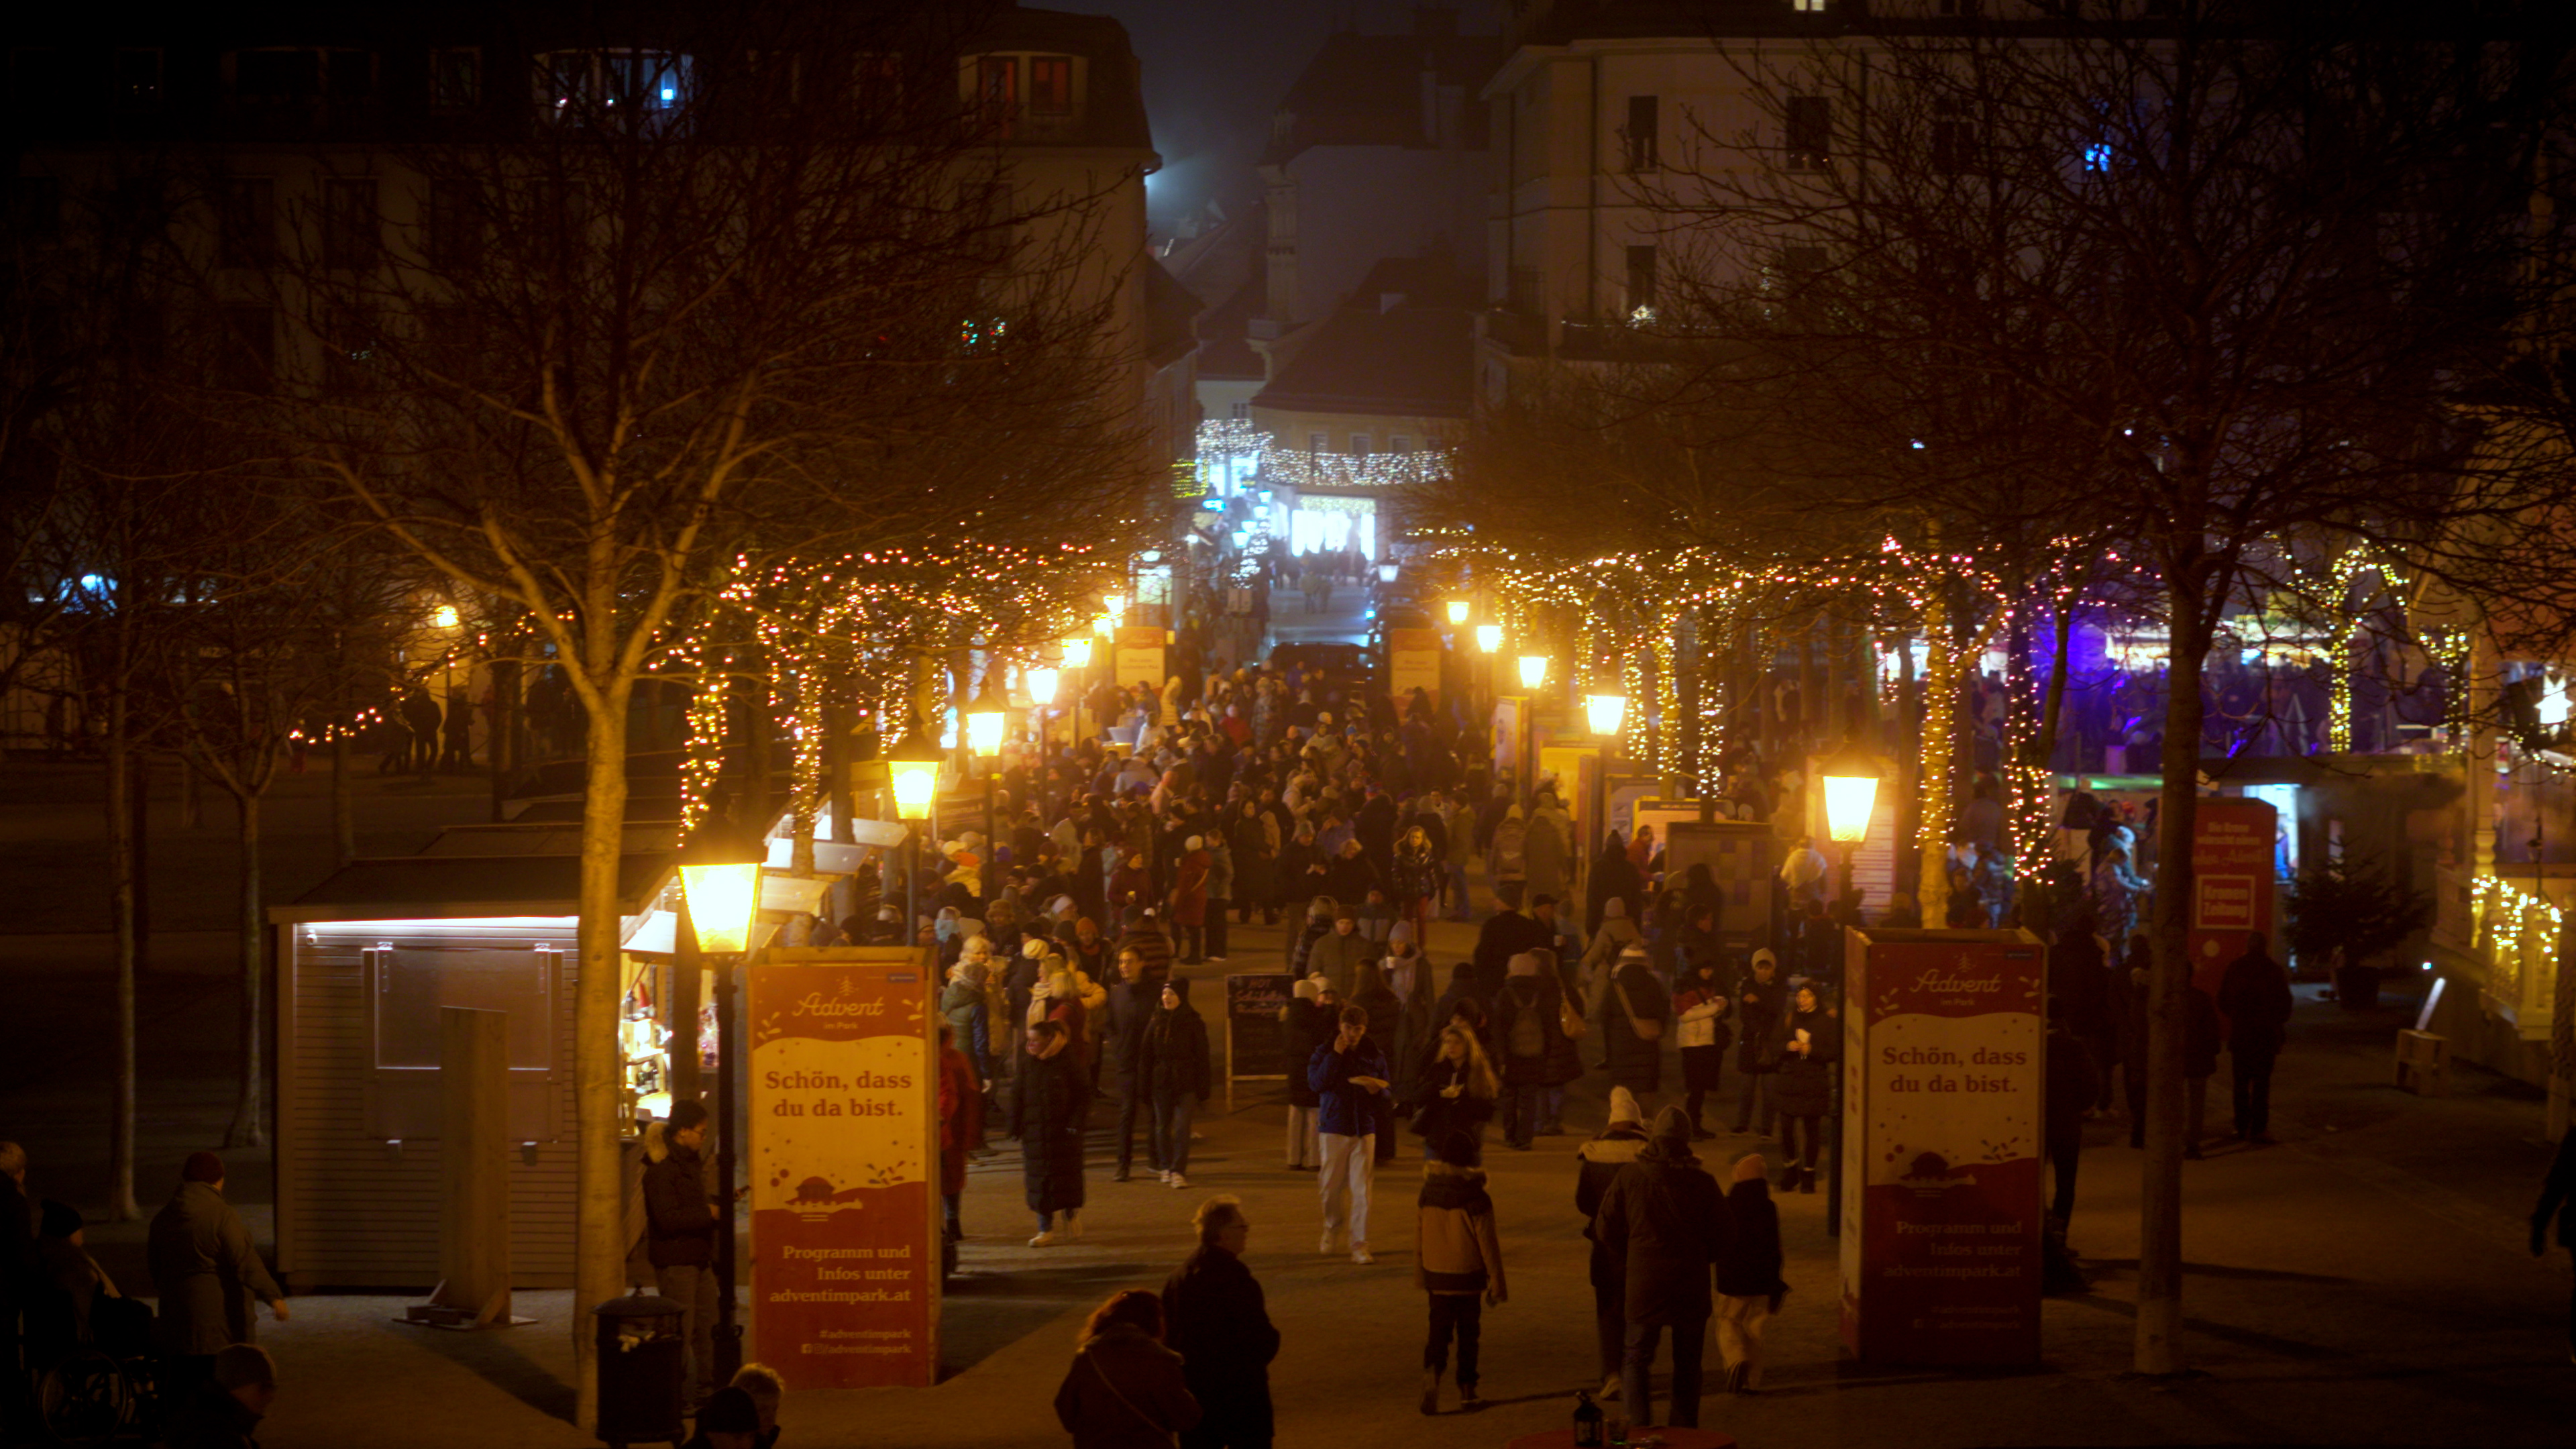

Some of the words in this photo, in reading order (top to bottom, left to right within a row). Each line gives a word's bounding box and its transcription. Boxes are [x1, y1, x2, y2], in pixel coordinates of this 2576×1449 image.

[1909, 968, 2001, 993] Advent
[792, 992, 885, 1017] Advent
[1882, 1047, 1964, 1068] Schön,
[1972, 1047, 2027, 1065] dass
[765, 1071, 849, 1091] Schön,
[856, 1071, 912, 1089] dass
[1890, 1075, 1919, 1092] du
[1928, 1075, 1957, 1092] da
[1966, 1075, 2017, 1092] bist.
[773, 1099, 804, 1116] du
[812, 1099, 842, 1116] da
[850, 1098, 903, 1116] bist.
[1896, 1221, 1986, 1237] Programm
[1990, 1221, 2022, 1234] und
[782, 1245, 873, 1262] Programm
[877, 1245, 911, 1258] und
[1930, 1242, 1972, 1255] Infos
[1976, 1244, 2022, 1255] unter
[817, 1267, 861, 1281] Infos
[865, 1269, 911, 1280] unter
[1883, 1264, 2021, 1281] adventimpark.at
[769, 1289, 912, 1304] adventimpark.at
[818, 1329, 912, 1340] #adventimpark
